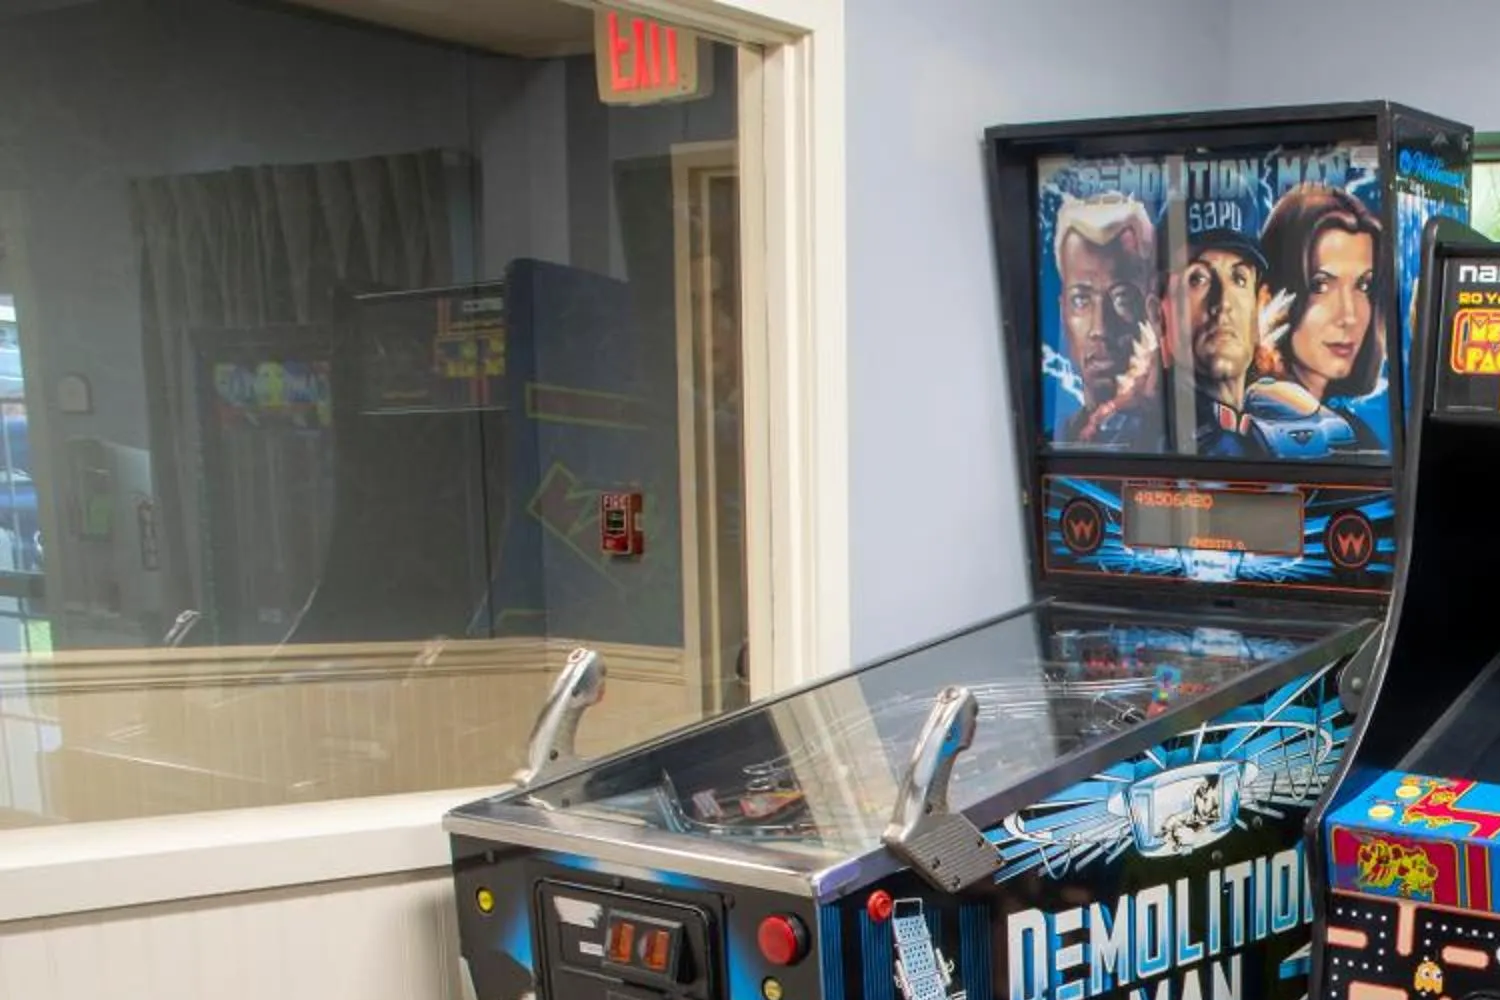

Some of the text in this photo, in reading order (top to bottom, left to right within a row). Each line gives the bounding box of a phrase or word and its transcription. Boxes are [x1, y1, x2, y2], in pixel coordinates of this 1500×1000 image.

[607, 9, 679, 92] EXIT
[1277, 154, 1347, 193] MAN
[1458, 292, 1484, 305] 20
